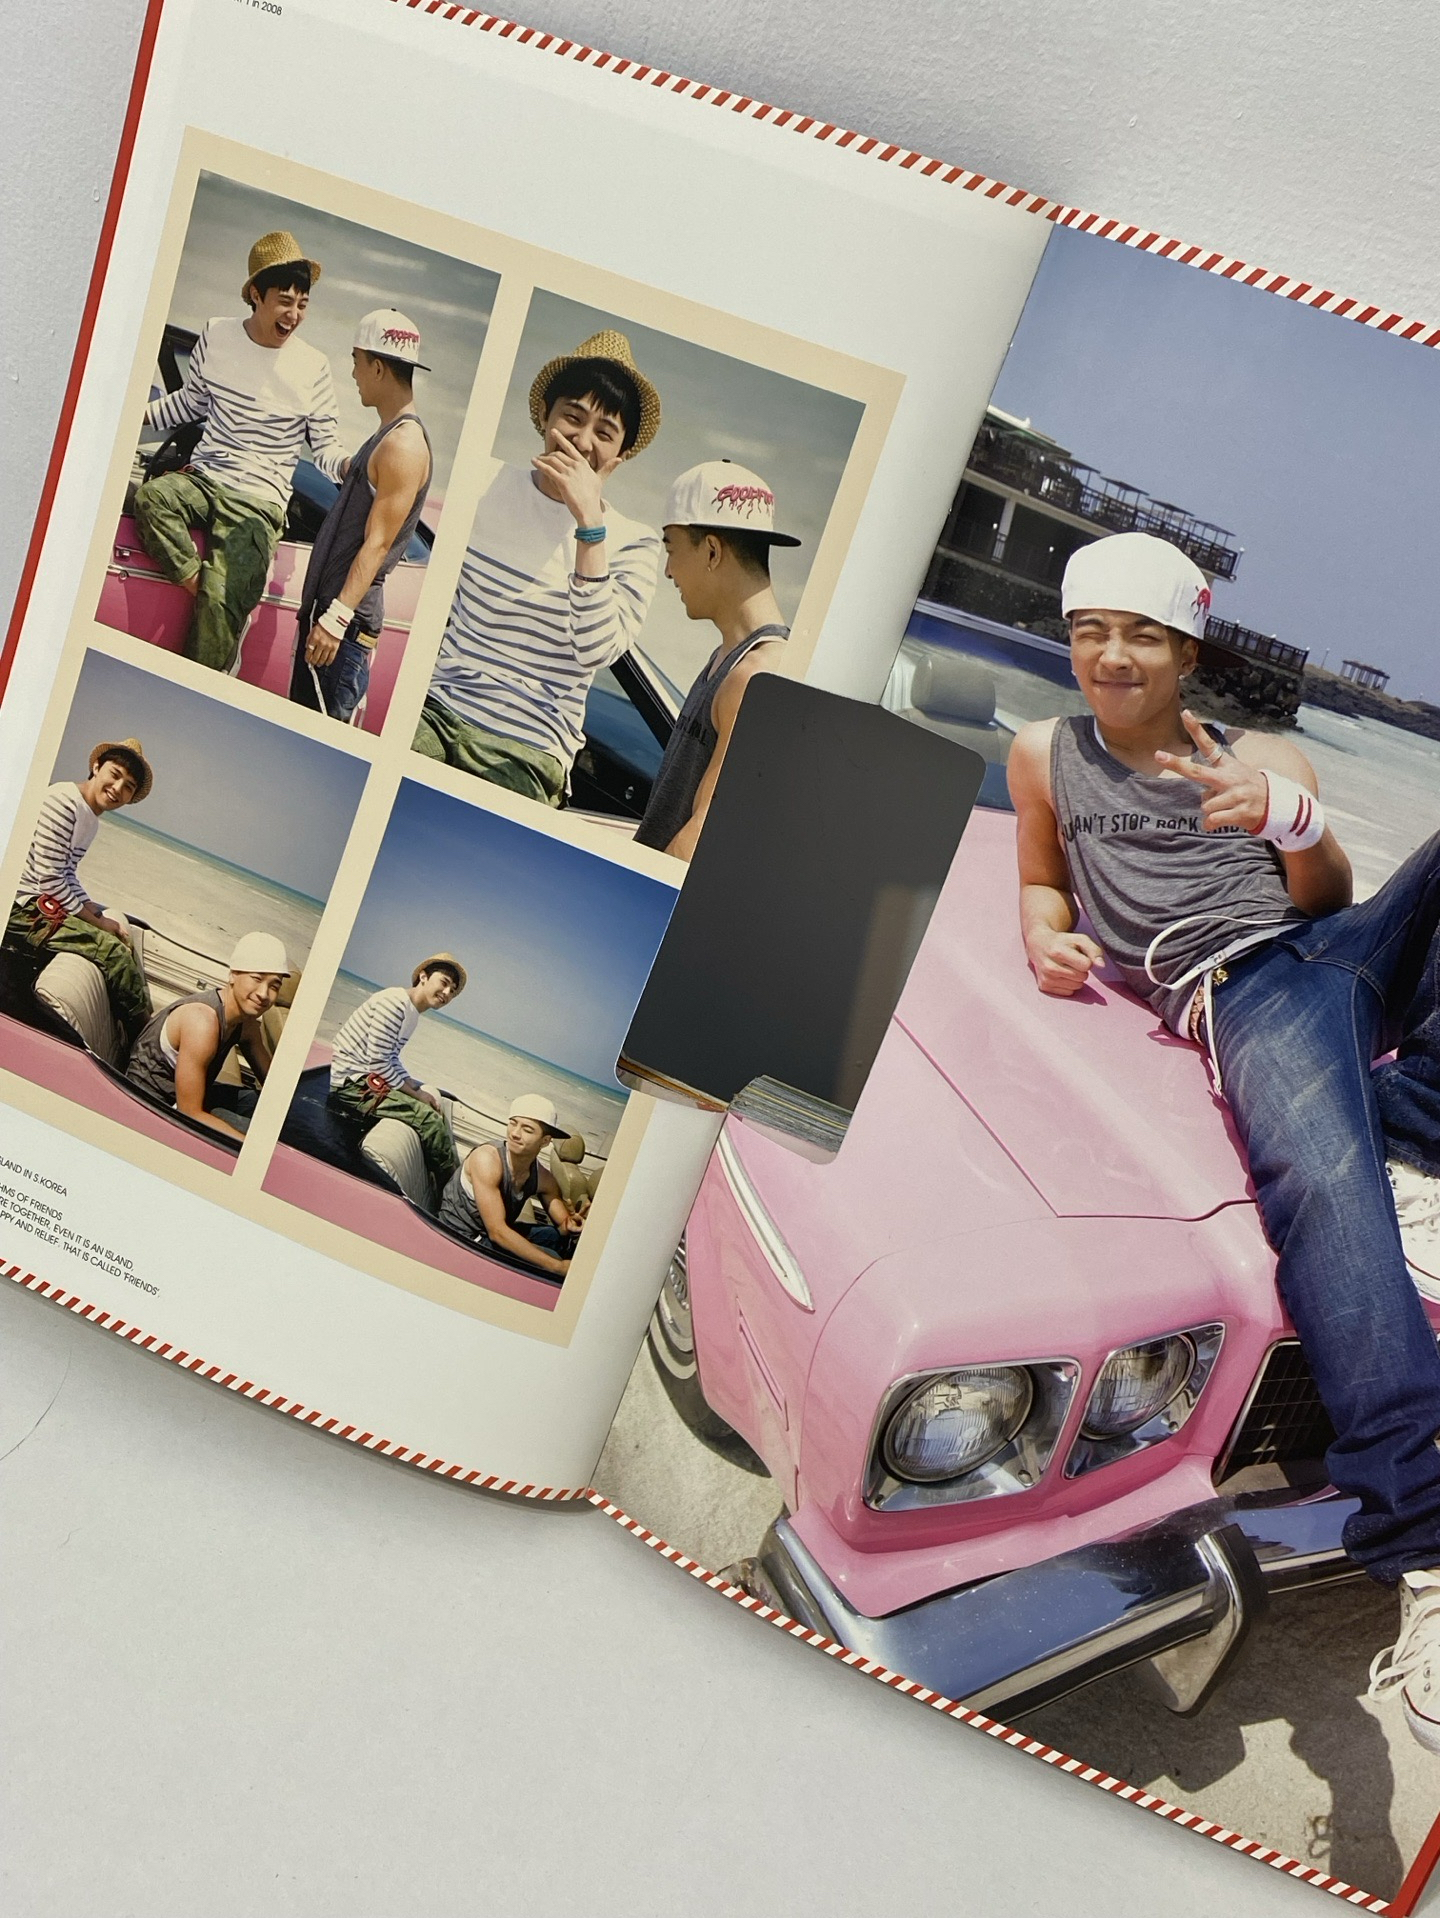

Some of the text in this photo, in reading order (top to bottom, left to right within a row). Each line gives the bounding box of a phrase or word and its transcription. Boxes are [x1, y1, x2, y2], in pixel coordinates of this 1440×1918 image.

[261, 1, 283, 16] 2008
[1111, 813, 1150, 834] STOP
[1156, 816, 1199, 833] ROCK
[0, 1156, 68, 1197] LAND IN S.KOREA
[16, 1192, 30, 1204] OF
[30, 1198, 64, 1222] FRIENDS
[0, 1210, 16, 1224] PPY
[14, 1218, 34, 1234] AND
[62, 1241, 82, 1258] THAT
[82, 1251, 90, 1262] IS
[90, 1256, 122, 1278] CALLED
[10, 1201, 52, 1230] TOGETHER,
[53, 1223, 75, 1241] EVEN
[75, 1234, 83, 1245] IT
[82, 1238, 91, 1249] IS
[90, 1243, 105, 1256] AN
[105, 1250, 135, 1272] ISLAND,
